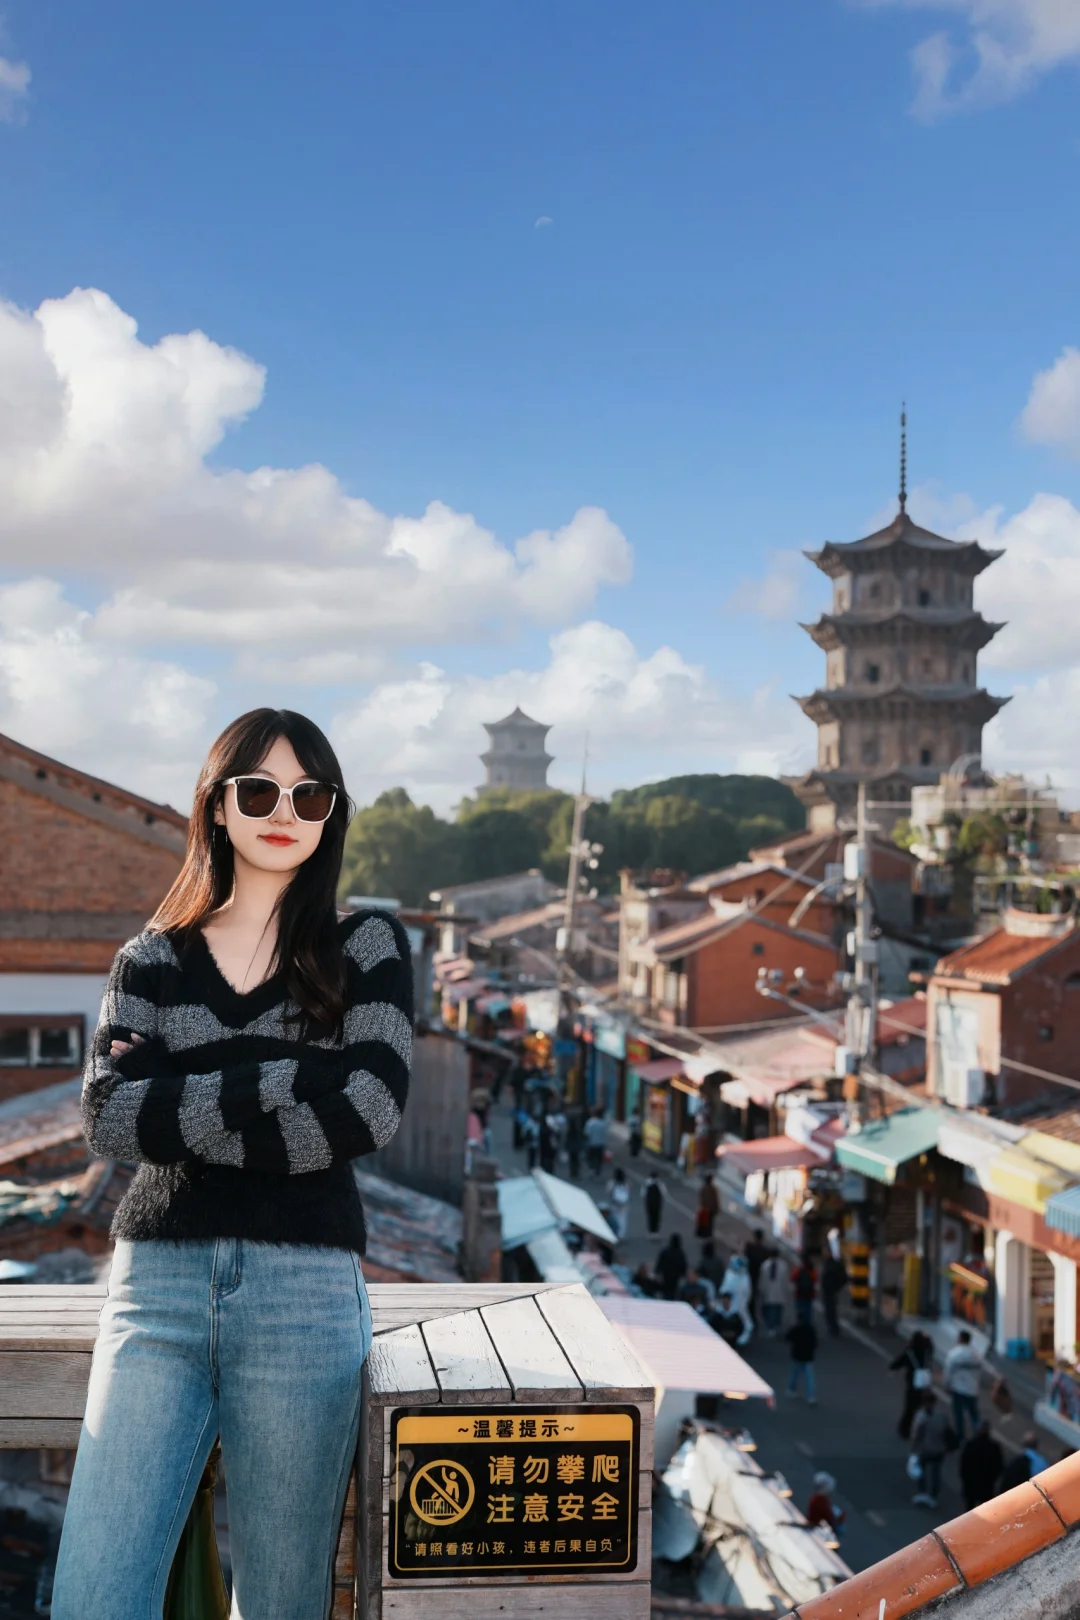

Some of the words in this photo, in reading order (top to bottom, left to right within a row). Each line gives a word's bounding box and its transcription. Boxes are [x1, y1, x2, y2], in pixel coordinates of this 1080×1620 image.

[487, 1454, 620, 1485] 请勿攀爬
[486, 1492, 620, 1524] 注意安全
